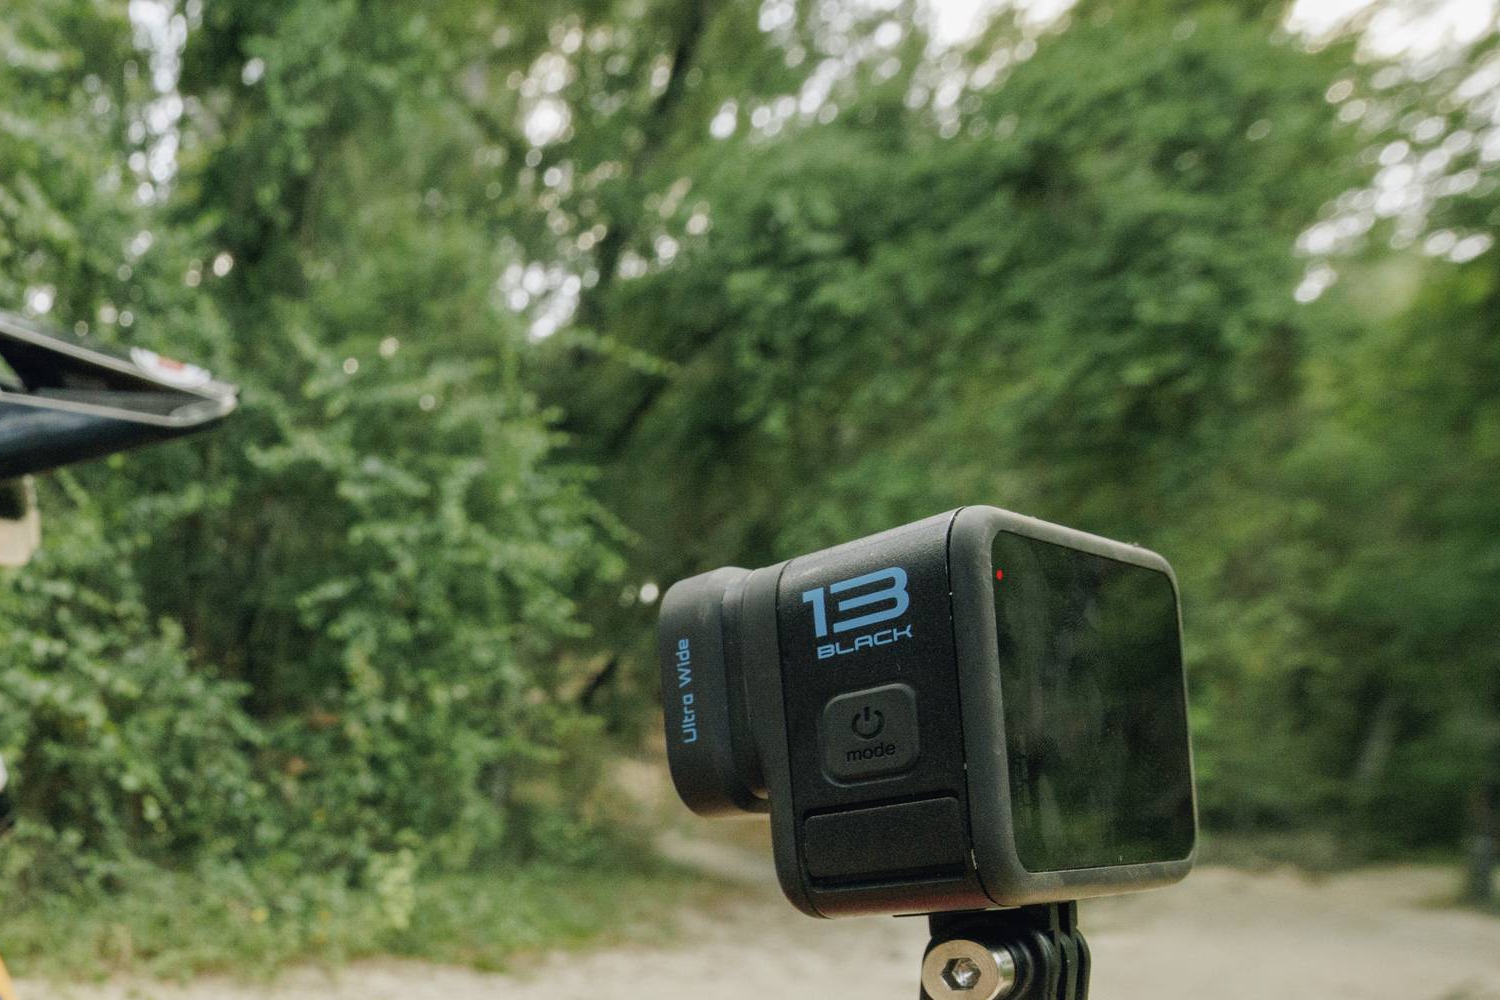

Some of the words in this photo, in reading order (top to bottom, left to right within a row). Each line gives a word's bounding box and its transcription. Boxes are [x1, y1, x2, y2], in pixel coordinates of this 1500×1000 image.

[802, 566, 910, 638] 13
[675, 638, 693, 689] Wide
[816, 623, 913, 660] BLACK
[681, 693, 698, 744] Ultra
[846, 742, 897, 762] mode
